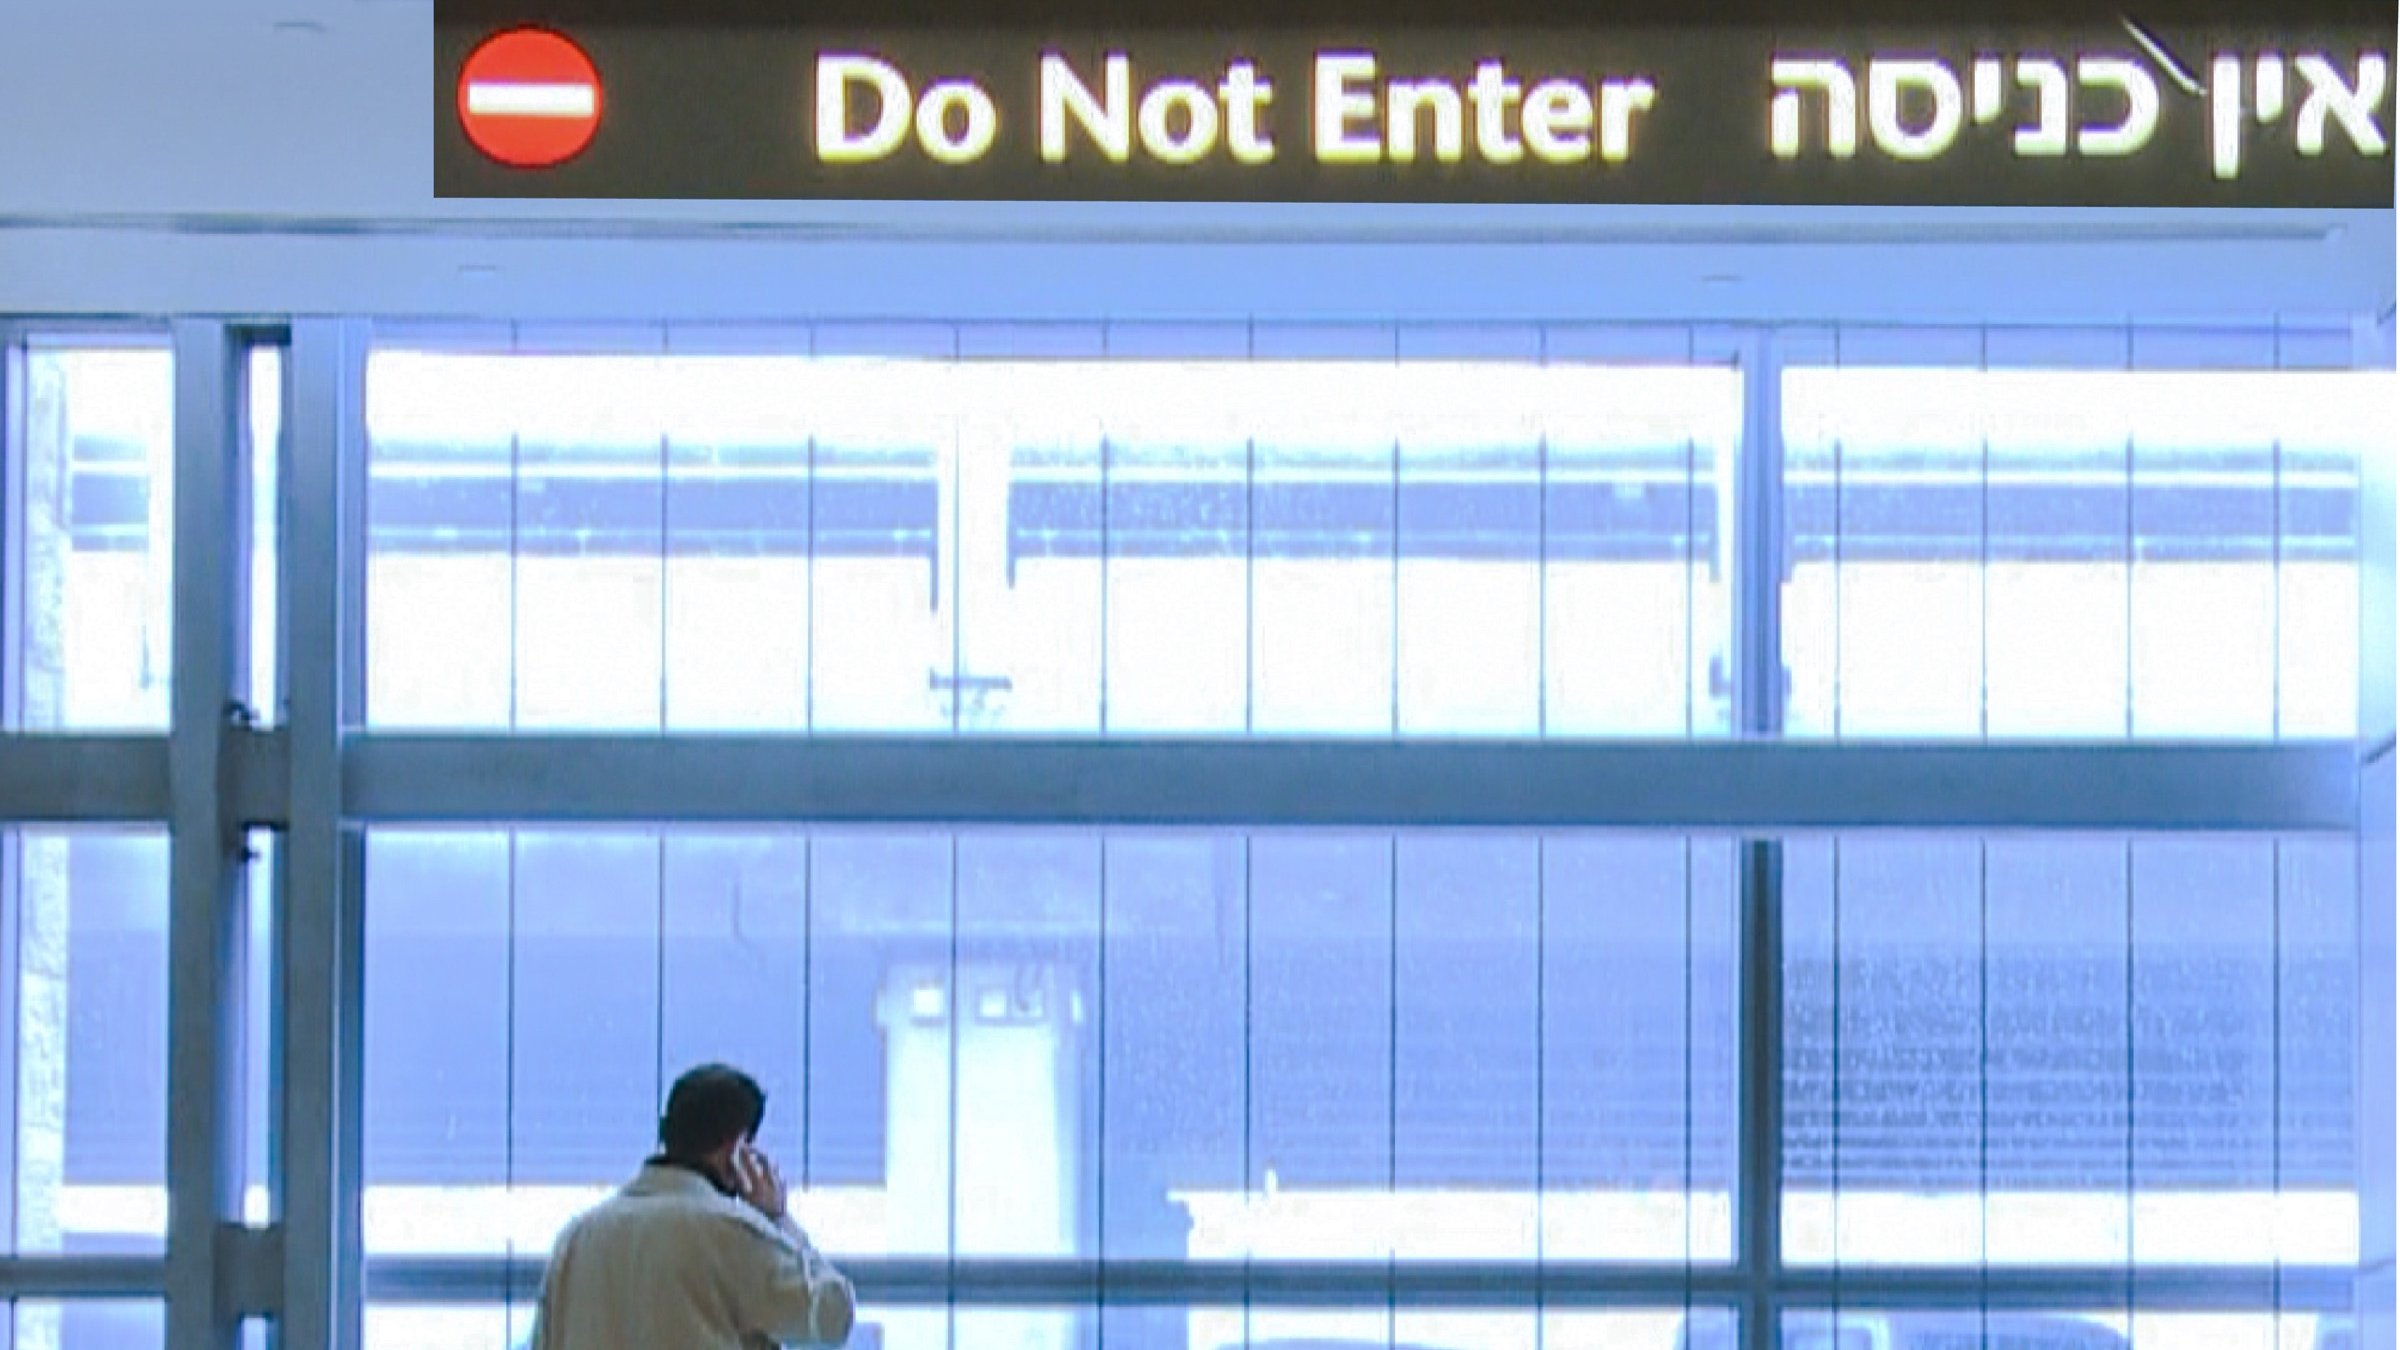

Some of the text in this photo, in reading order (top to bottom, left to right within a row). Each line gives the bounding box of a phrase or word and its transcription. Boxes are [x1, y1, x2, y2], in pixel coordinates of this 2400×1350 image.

[814, 52, 1656, 163] Do Not Enter
[1769, 53, 2389, 179] אין כניסה
